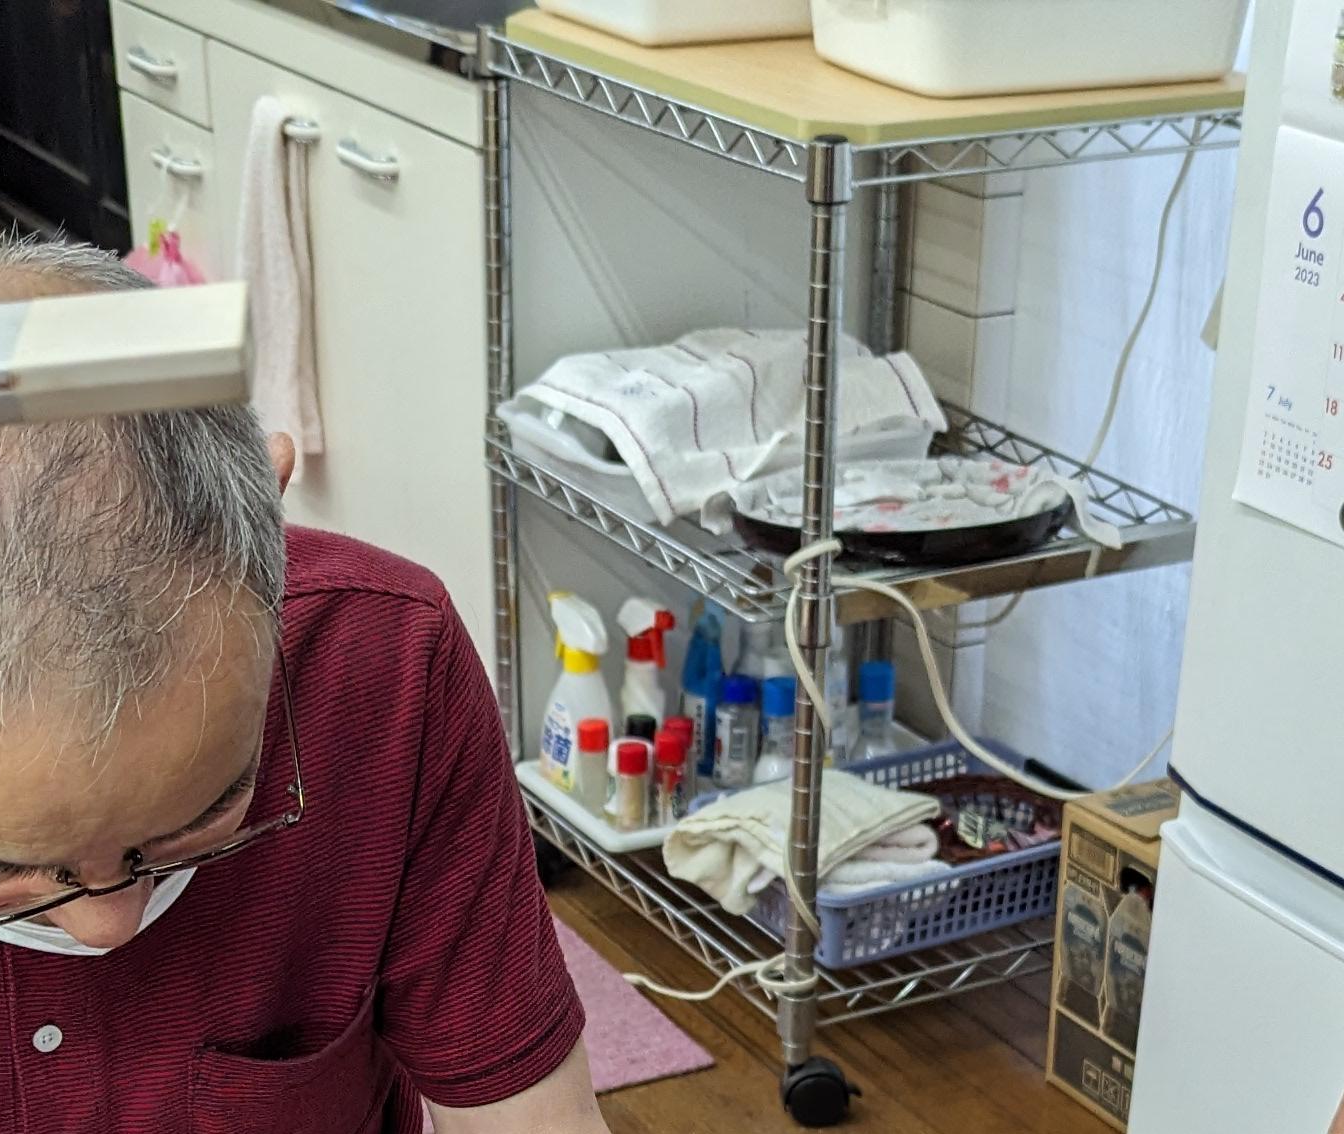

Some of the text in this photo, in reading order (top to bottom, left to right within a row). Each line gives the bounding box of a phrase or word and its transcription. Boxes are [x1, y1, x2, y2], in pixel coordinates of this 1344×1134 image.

[1302, 187, 1324, 239] 6
[1295, 242, 1324, 266] June
[1294, 266, 1321, 287] 2023
[1332, 343, 1343, 361] 11
[1266, 385, 1275, 400] 7
[1325, 397, 1338, 416] 18
[1317, 451, 1333, 470] 25
